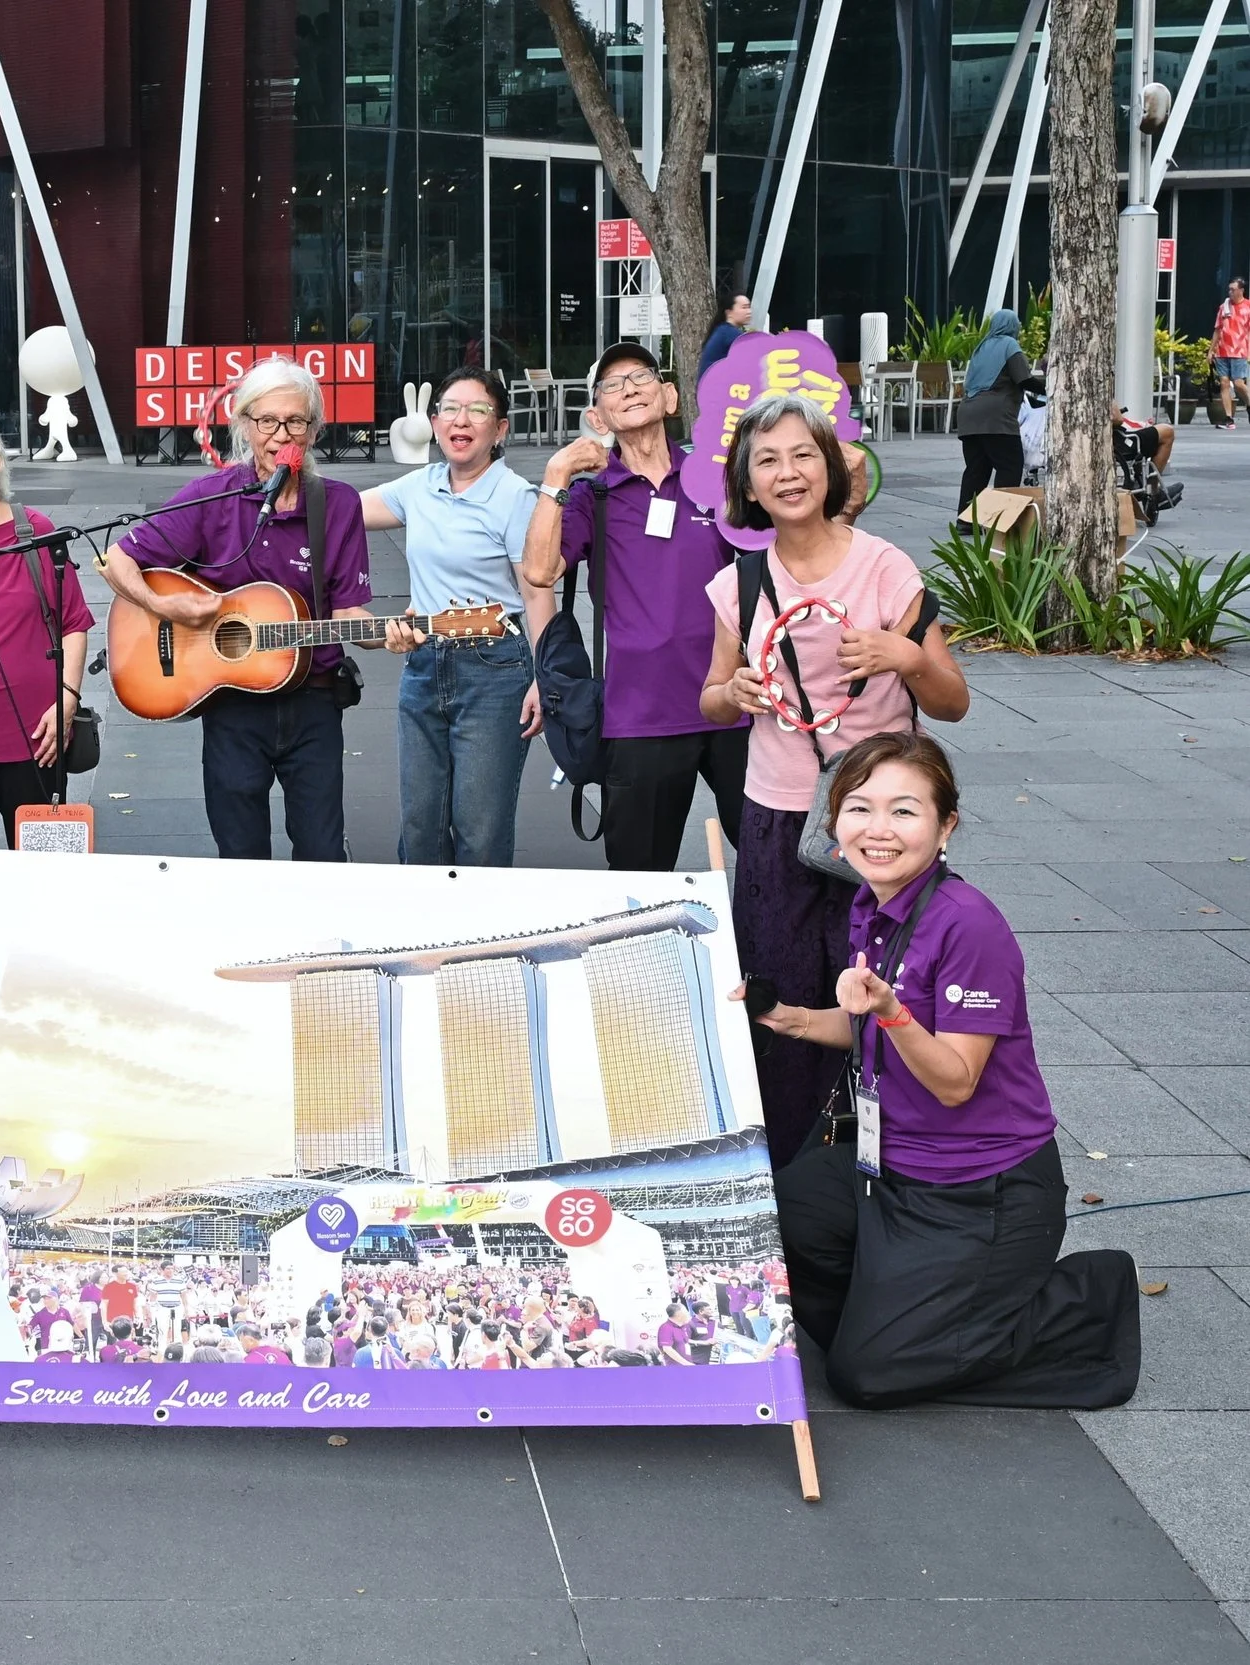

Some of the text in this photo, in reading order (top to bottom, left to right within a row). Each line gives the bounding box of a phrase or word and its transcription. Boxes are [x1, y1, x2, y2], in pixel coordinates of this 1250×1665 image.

[145, 349, 366, 382] DESGN
[963, 989, 990, 998] Cares
[560, 1196, 597, 1216] SG
[558, 1215, 596, 1237] 60
[4, 1379, 84, 1405] Serve
[93, 1379, 152, 1406] with
[159, 1379, 228, 1408] Love
[237, 1382, 293, 1409] and
[302, 1381, 371, 1414] Care
